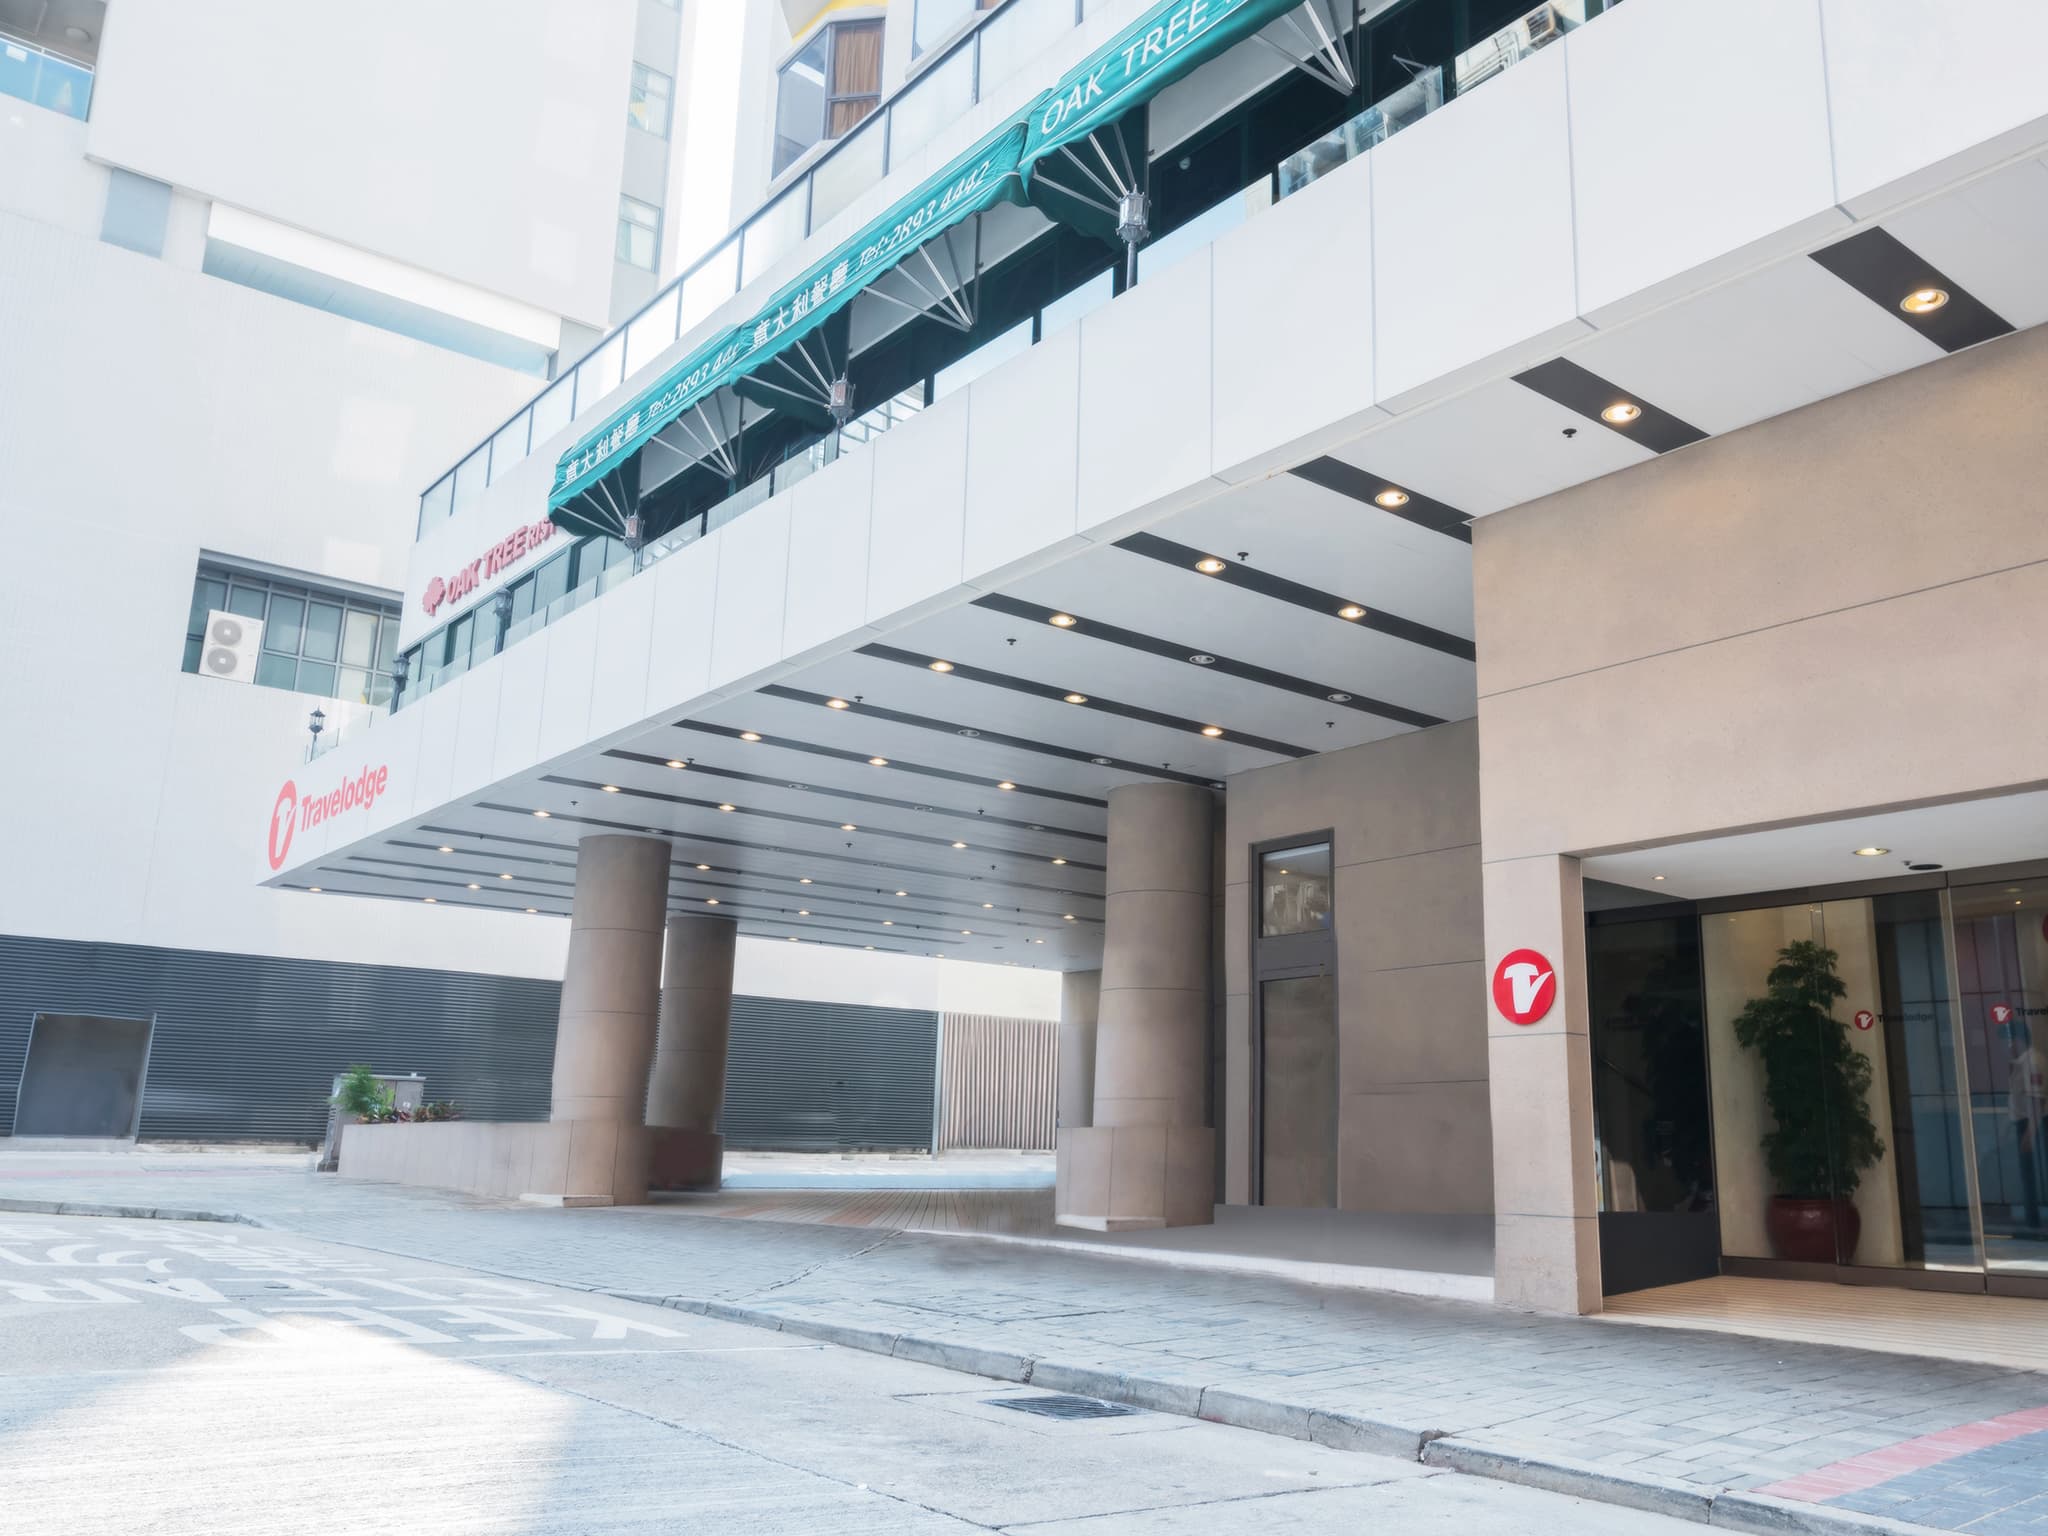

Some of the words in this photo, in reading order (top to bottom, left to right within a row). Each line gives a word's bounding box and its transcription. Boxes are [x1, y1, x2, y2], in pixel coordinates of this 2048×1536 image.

[1041, 63, 1107, 135] OAK
[1121, 0, 1209, 77] TREE
[940, 160, 990, 211] 4442
[447, 558, 482, 604] OAK
[484, 525, 528, 579] TREE
[301, 764, 389, 833] Travelodge
[1877, 1011, 1936, 1024] Tlodge
